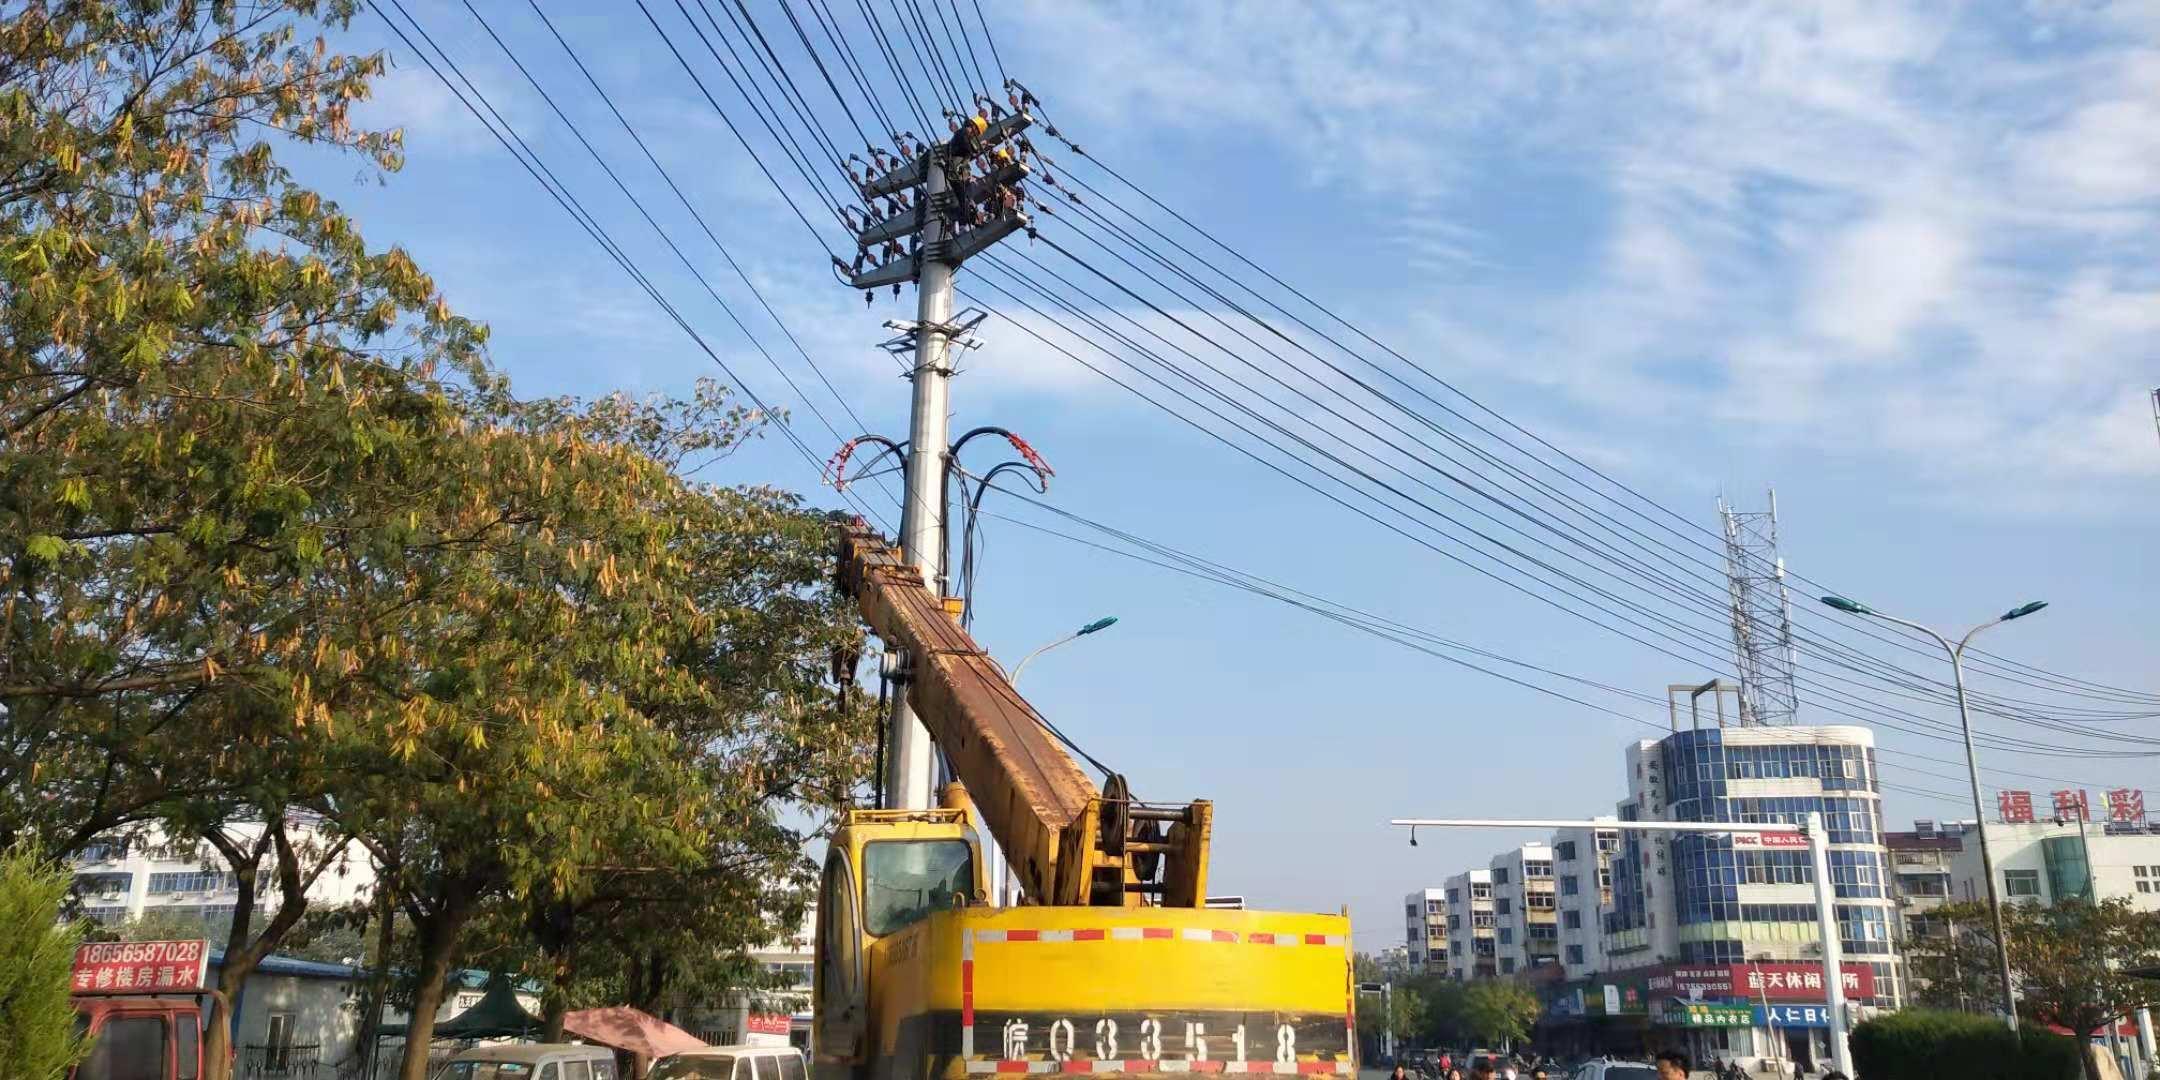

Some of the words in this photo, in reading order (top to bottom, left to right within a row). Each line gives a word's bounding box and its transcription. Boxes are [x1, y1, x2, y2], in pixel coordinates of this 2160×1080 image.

[82, 942, 200, 964] 18656587028
[76, 965, 195, 988] 专修楼房漏水
[1747, 970, 1859, 990] 蓝天休闲所
